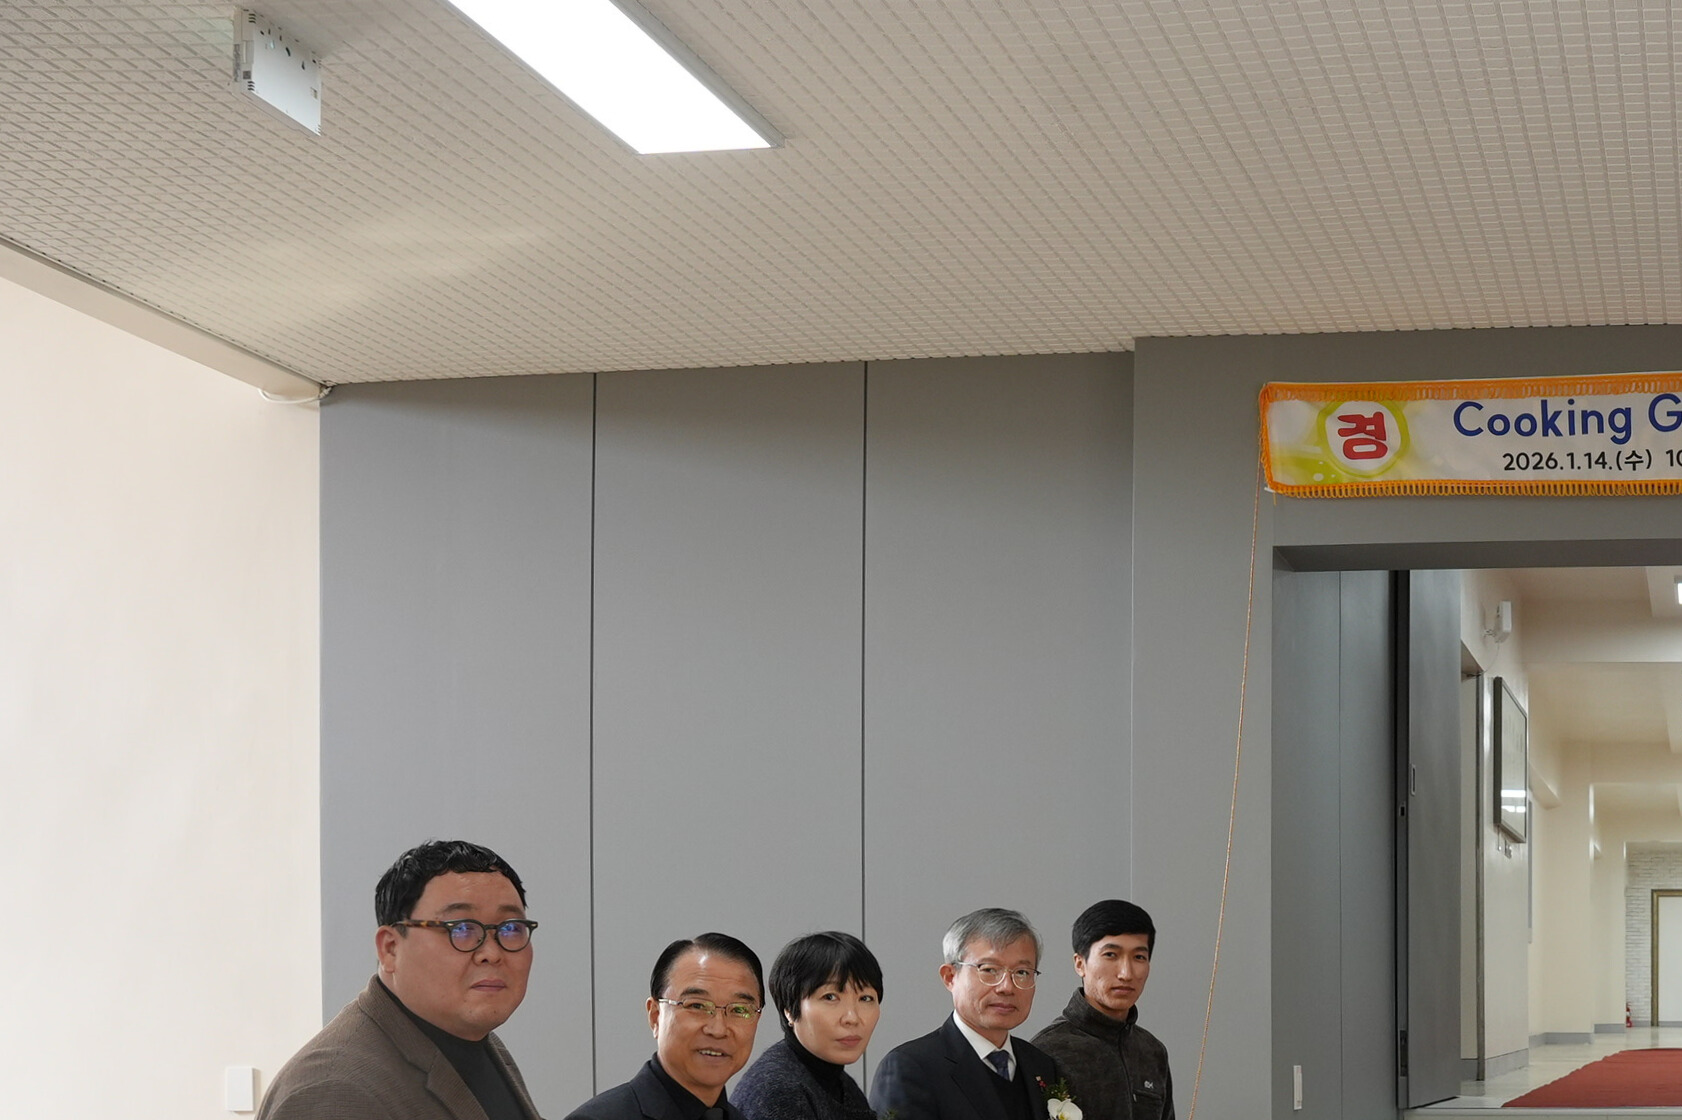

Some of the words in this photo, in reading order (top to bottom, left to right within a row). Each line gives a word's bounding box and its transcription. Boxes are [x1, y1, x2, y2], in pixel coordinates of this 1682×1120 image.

[1337, 411, 1388, 460] 경
[1454, 399, 1631, 445] Cooking
[1502, 448, 1653, 472] 2026.1.14.(수)
